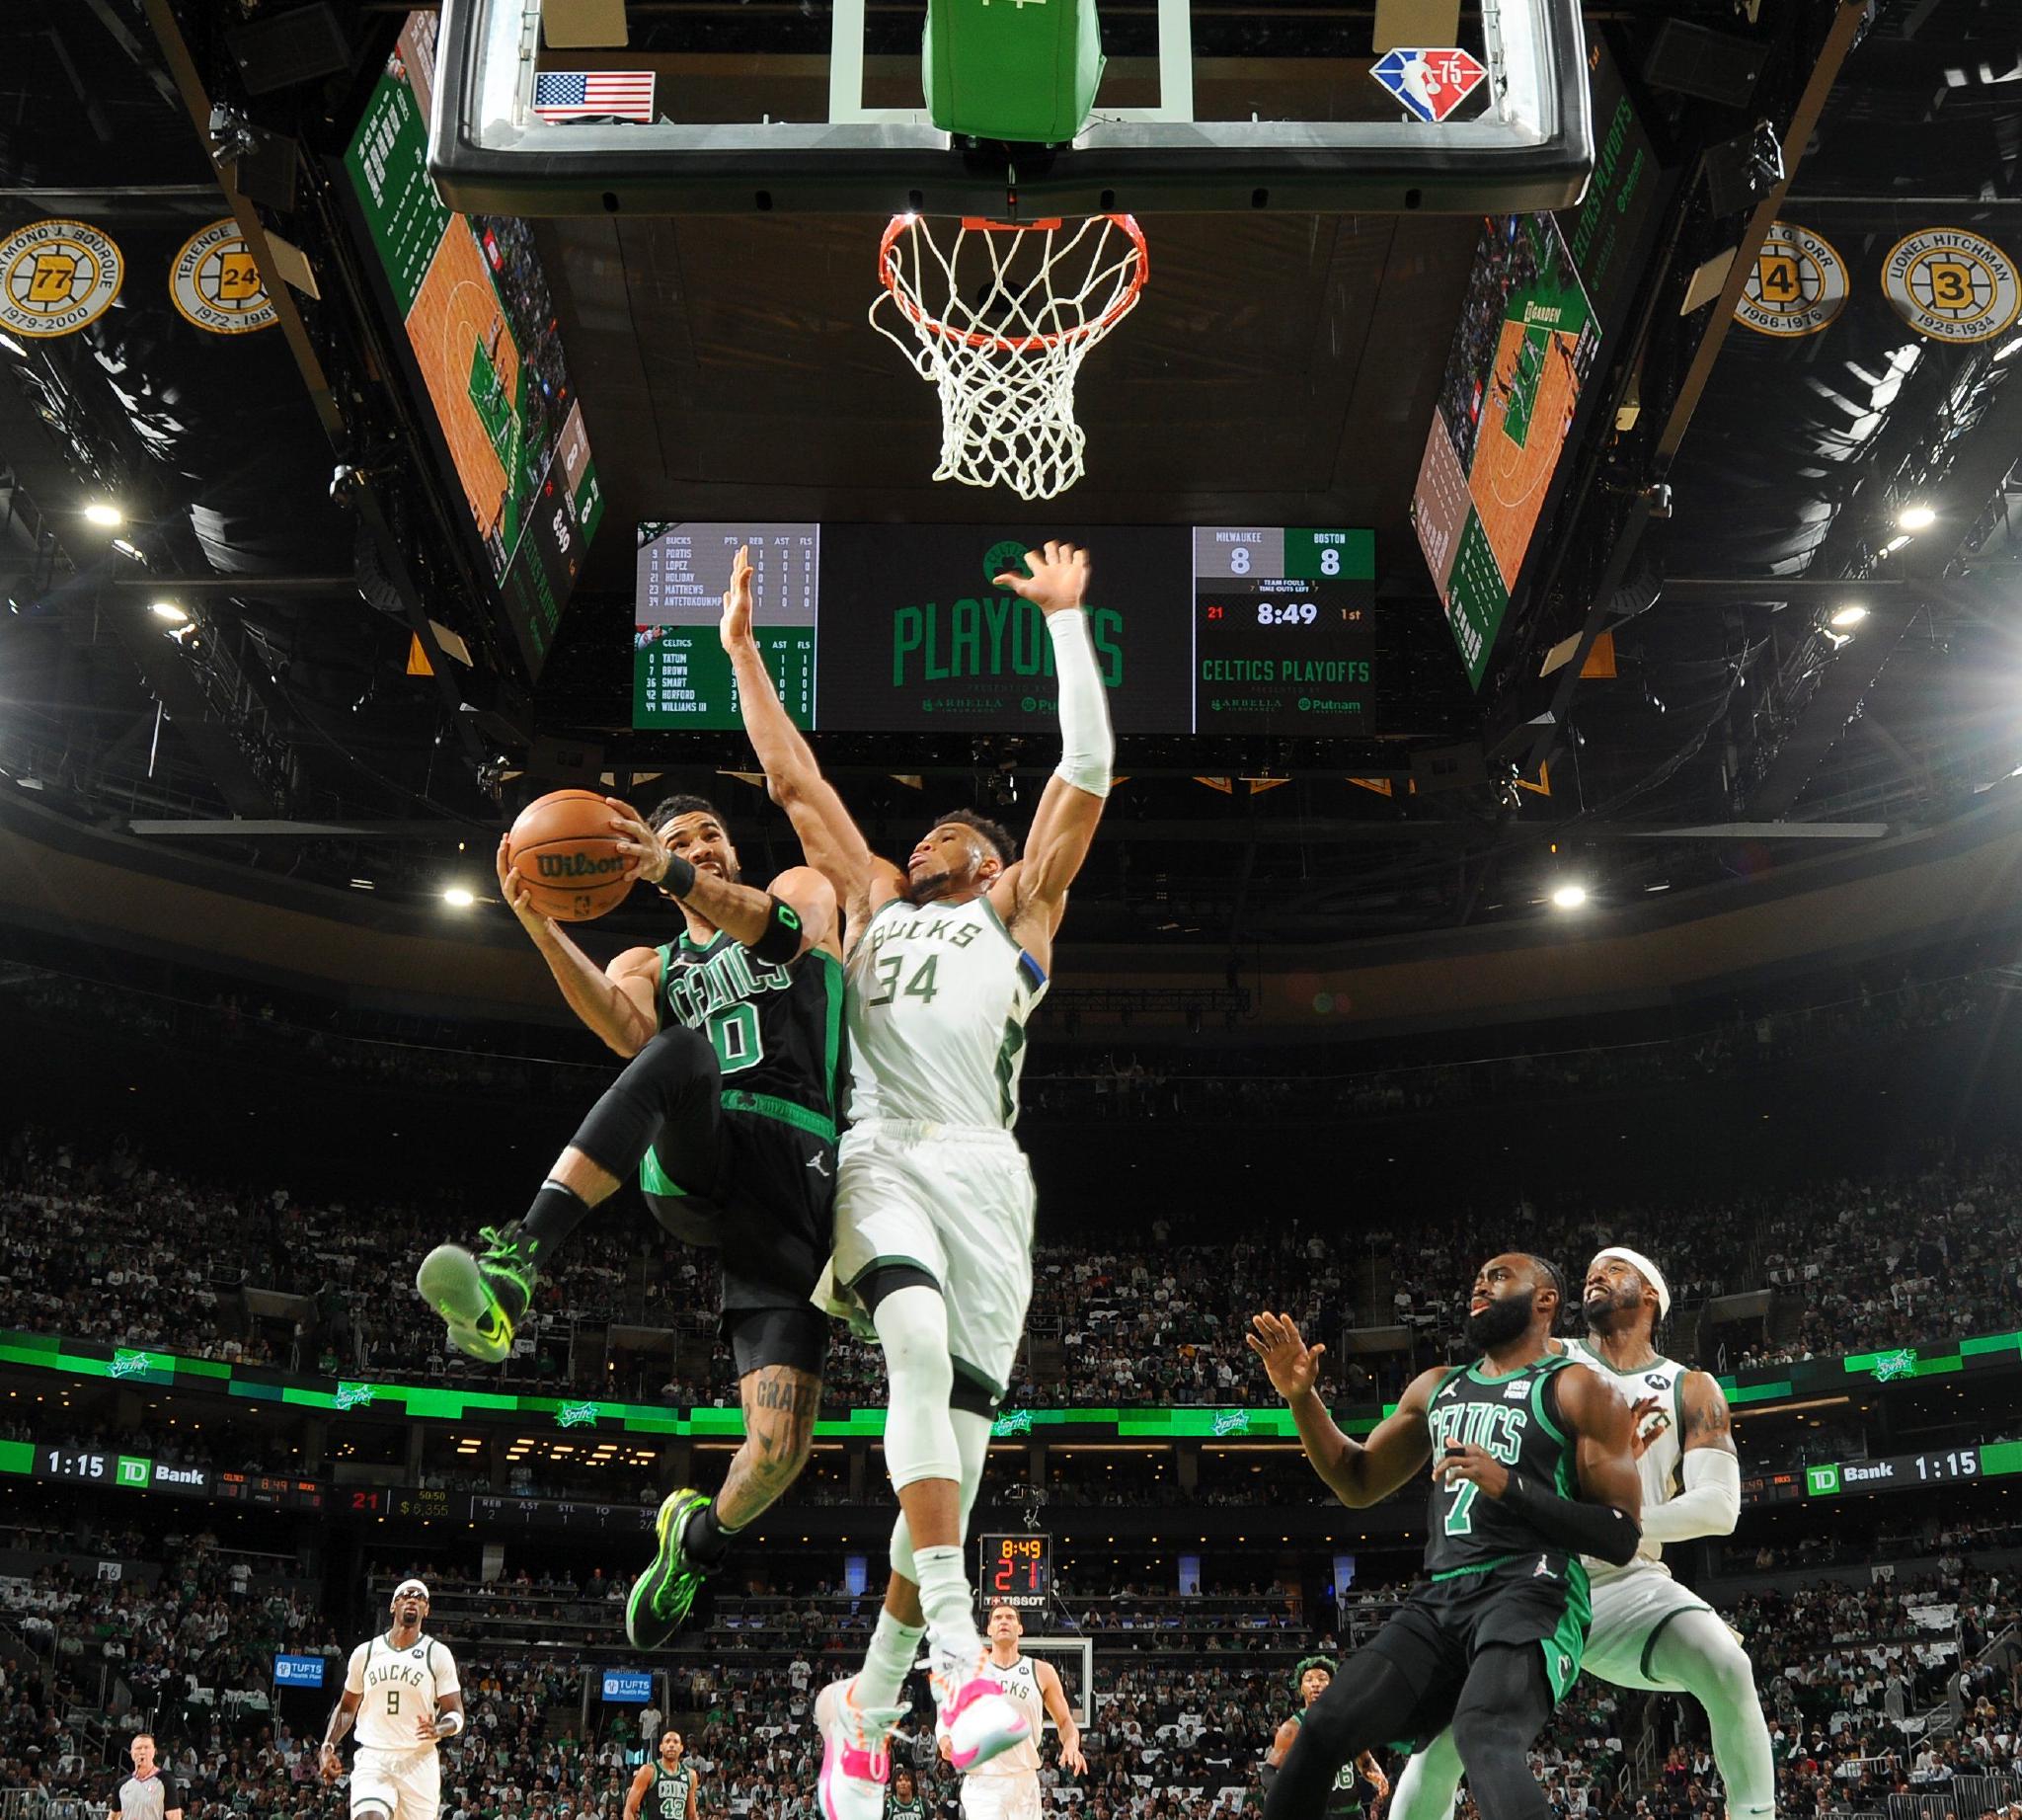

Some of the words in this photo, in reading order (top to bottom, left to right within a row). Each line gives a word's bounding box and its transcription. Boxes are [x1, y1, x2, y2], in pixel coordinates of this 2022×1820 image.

[1439, 60, 1462, 85] 75
[0, 227, 48, 284] AYMOND
[54, 227, 66, 237] J.
[73, 229, 116, 289] BOURQUE
[178, 226, 231, 280] TERENCE
[1804, 239, 1833, 268] ORR
[1891, 239, 1930, 278] LIONEL
[1933, 235, 2010, 281] HITCHMAN
[38, 269, 72, 288] 77
[223, 268, 257, 285] 24
[1766, 264, 1794, 293] 4
[1937, 271, 1965, 301] 3
[2, 306, 89, 330] 1979-2000
[1531, 305, 1562, 324] GARDEN
[1743, 306, 1823, 329] 1966-1976
[1917, 314, 1995, 335] 1925-1934
[748, 536, 764, 545] REB
[774, 536, 790, 545] AST
[1215, 531, 1263, 543] MILWAUKEE
[1313, 533, 1346, 544] BOSTON
[665, 548, 692, 559] PORTIS
[1230, 547, 1251, 575] 8
[1320, 548, 1341, 576] 8
[665, 560, 688, 570] LOPEZ
[664, 573, 695, 583] HOLIDAY
[664, 585, 704, 594] MATTHEWS
[663, 596, 723, 606] ANTETOKOUNMP
[1207, 606, 1224, 619] 21
[1257, 602, 1318, 625] 8:49
[1342, 609, 1361, 621] 1st
[894, 596, 1123, 688] PLAYOS
[649, 653, 655, 664] 0
[662, 653, 687, 664] TATUM
[649, 666, 655, 675] 7
[661, 666, 688, 675] BROWN
[1203, 660, 1275, 681] CELTICS
[1282, 660, 1370, 682] PLAYOFFS
[646, 677, 657, 687] 36
[661, 677, 687, 687] SMART
[661, 689, 695, 700] HORFORD
[1313, 699, 1361, 710] Putnam
[661, 702, 697, 712] WILLIAMS
[731, 702, 738, 712] 2
[536, 852, 624, 877] Wilson
[778, 906, 800, 931] 0
[871, 919, 983, 954] BUCKS
[667, 944, 793, 1030] CELTICS
[866, 953, 940, 1010] 34
[706, 998, 764, 1075] 0
[115, 1356, 146, 1372] Sprite
[564, 1407, 593, 1421] Sprite
[1216, 1415, 1248, 1431] Sprite
[997, 1416, 1028, 1433] Sprite
[1429, 1401, 1527, 1465] CELTICS
[48, 1451, 105, 1478] 1:15
[119, 1461, 147, 1482] TD
[1843, 1462, 1895, 1482] Bank
[1915, 1451, 1977, 1480] 1:15
[155, 1465, 204, 1485] Bank
[1810, 1470, 1836, 1489] TD
[352, 1491, 378, 1510] 21
[419, 1490, 445, 1502] 50/50
[1444, 1470, 1479, 1537] 7
[481, 1498, 503, 1508] REB
[518, 1500, 540, 1511] AST
[557, 1503, 577, 1514] STL
[594, 1505, 611, 1517] TO
[488, 1509, 496, 1521] 2
[1002, 1540, 1041, 1559] 8:49
[994, 1558, 1038, 1591] 21
[1001, 1596, 1047, 1607] TISSOT
[291, 1663, 322, 1675] TUFTS
[368, 1664, 425, 1687] BUCKS
[619, 1679, 650, 1690] TUFTS
[1000, 1680, 1030, 1700] CKS
[387, 1691, 400, 1715] 9
[660, 1797, 686, 1820] 42
